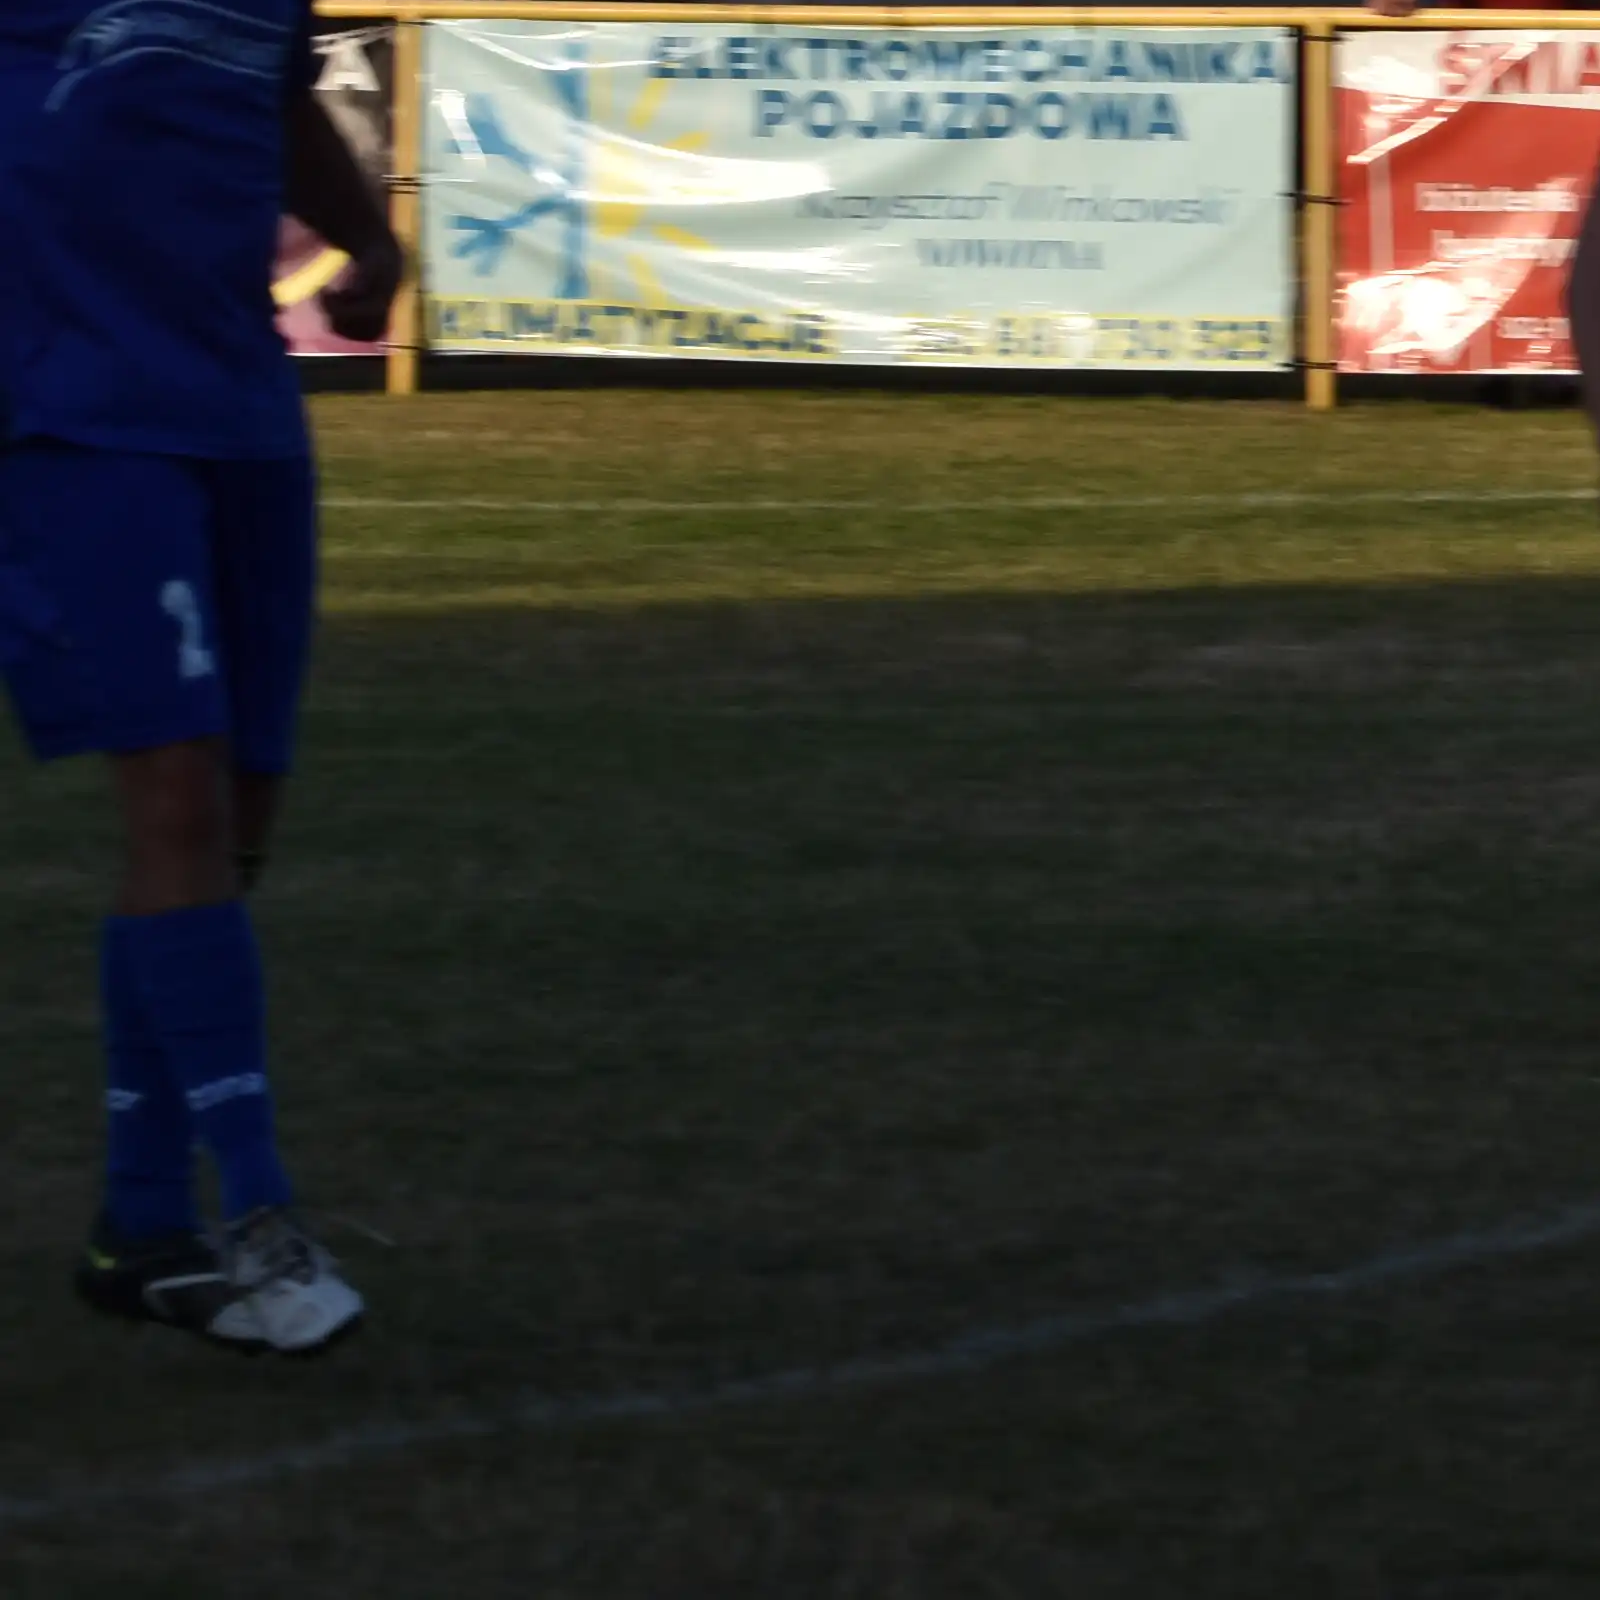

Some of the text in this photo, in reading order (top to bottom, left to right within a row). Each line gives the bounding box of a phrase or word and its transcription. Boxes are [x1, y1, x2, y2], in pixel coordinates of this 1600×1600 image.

[650, 36, 1290, 83] ELEKTROMECHANIKA
[752, 88, 1190, 141] POJAZDOWA
[159, 578, 216, 681] 1
